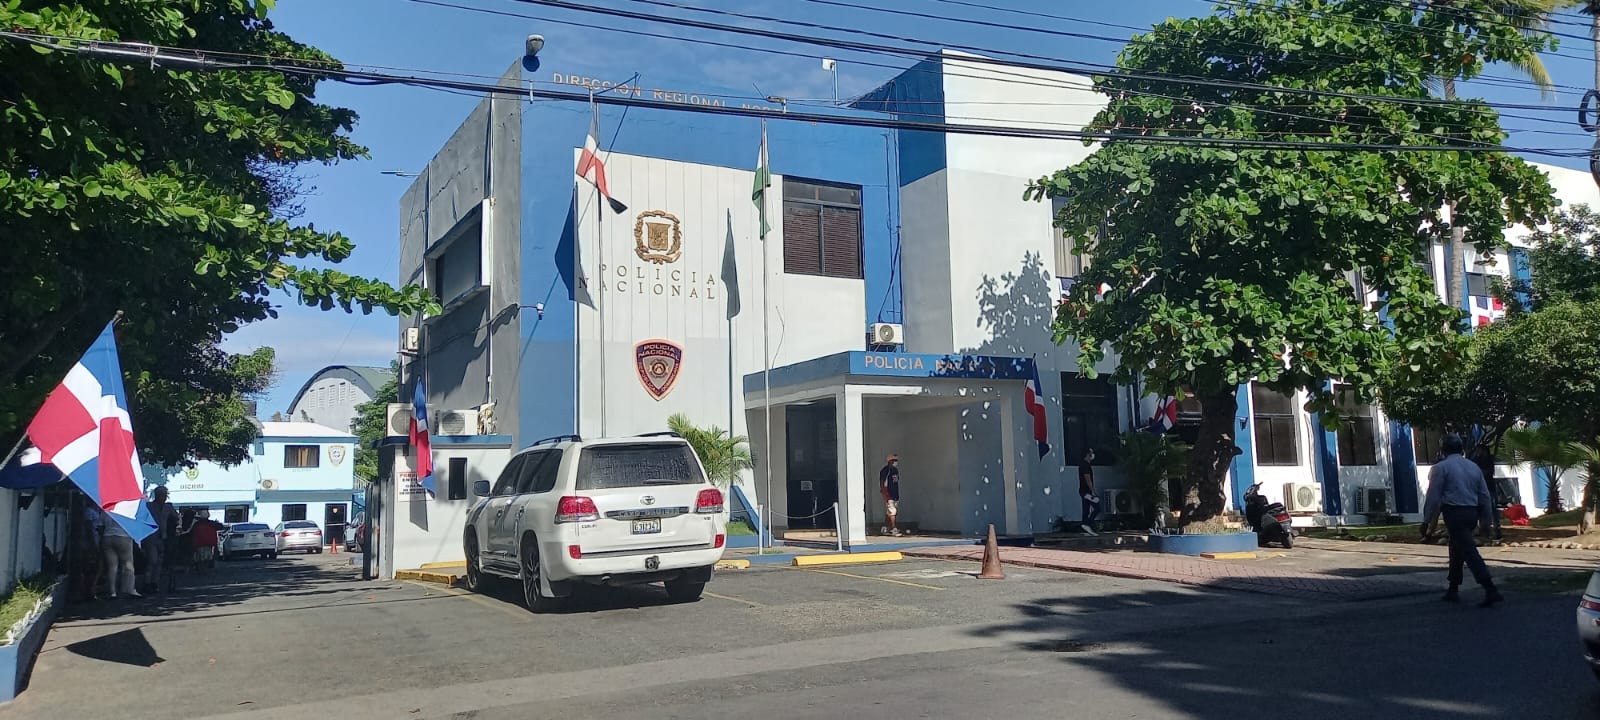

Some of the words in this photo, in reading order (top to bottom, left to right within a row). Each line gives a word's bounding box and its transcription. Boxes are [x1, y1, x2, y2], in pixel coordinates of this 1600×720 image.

[553, 72, 641, 97] DIRECCION
[653, 88, 728, 107] REGIONAL
[599, 264, 715, 285] POLICIA
[578, 277, 715, 299] NACIONAL
[638, 350, 680, 361] NACIONAL
[643, 344, 675, 353] POLICIA
[865, 355, 924, 370] POLICIA
